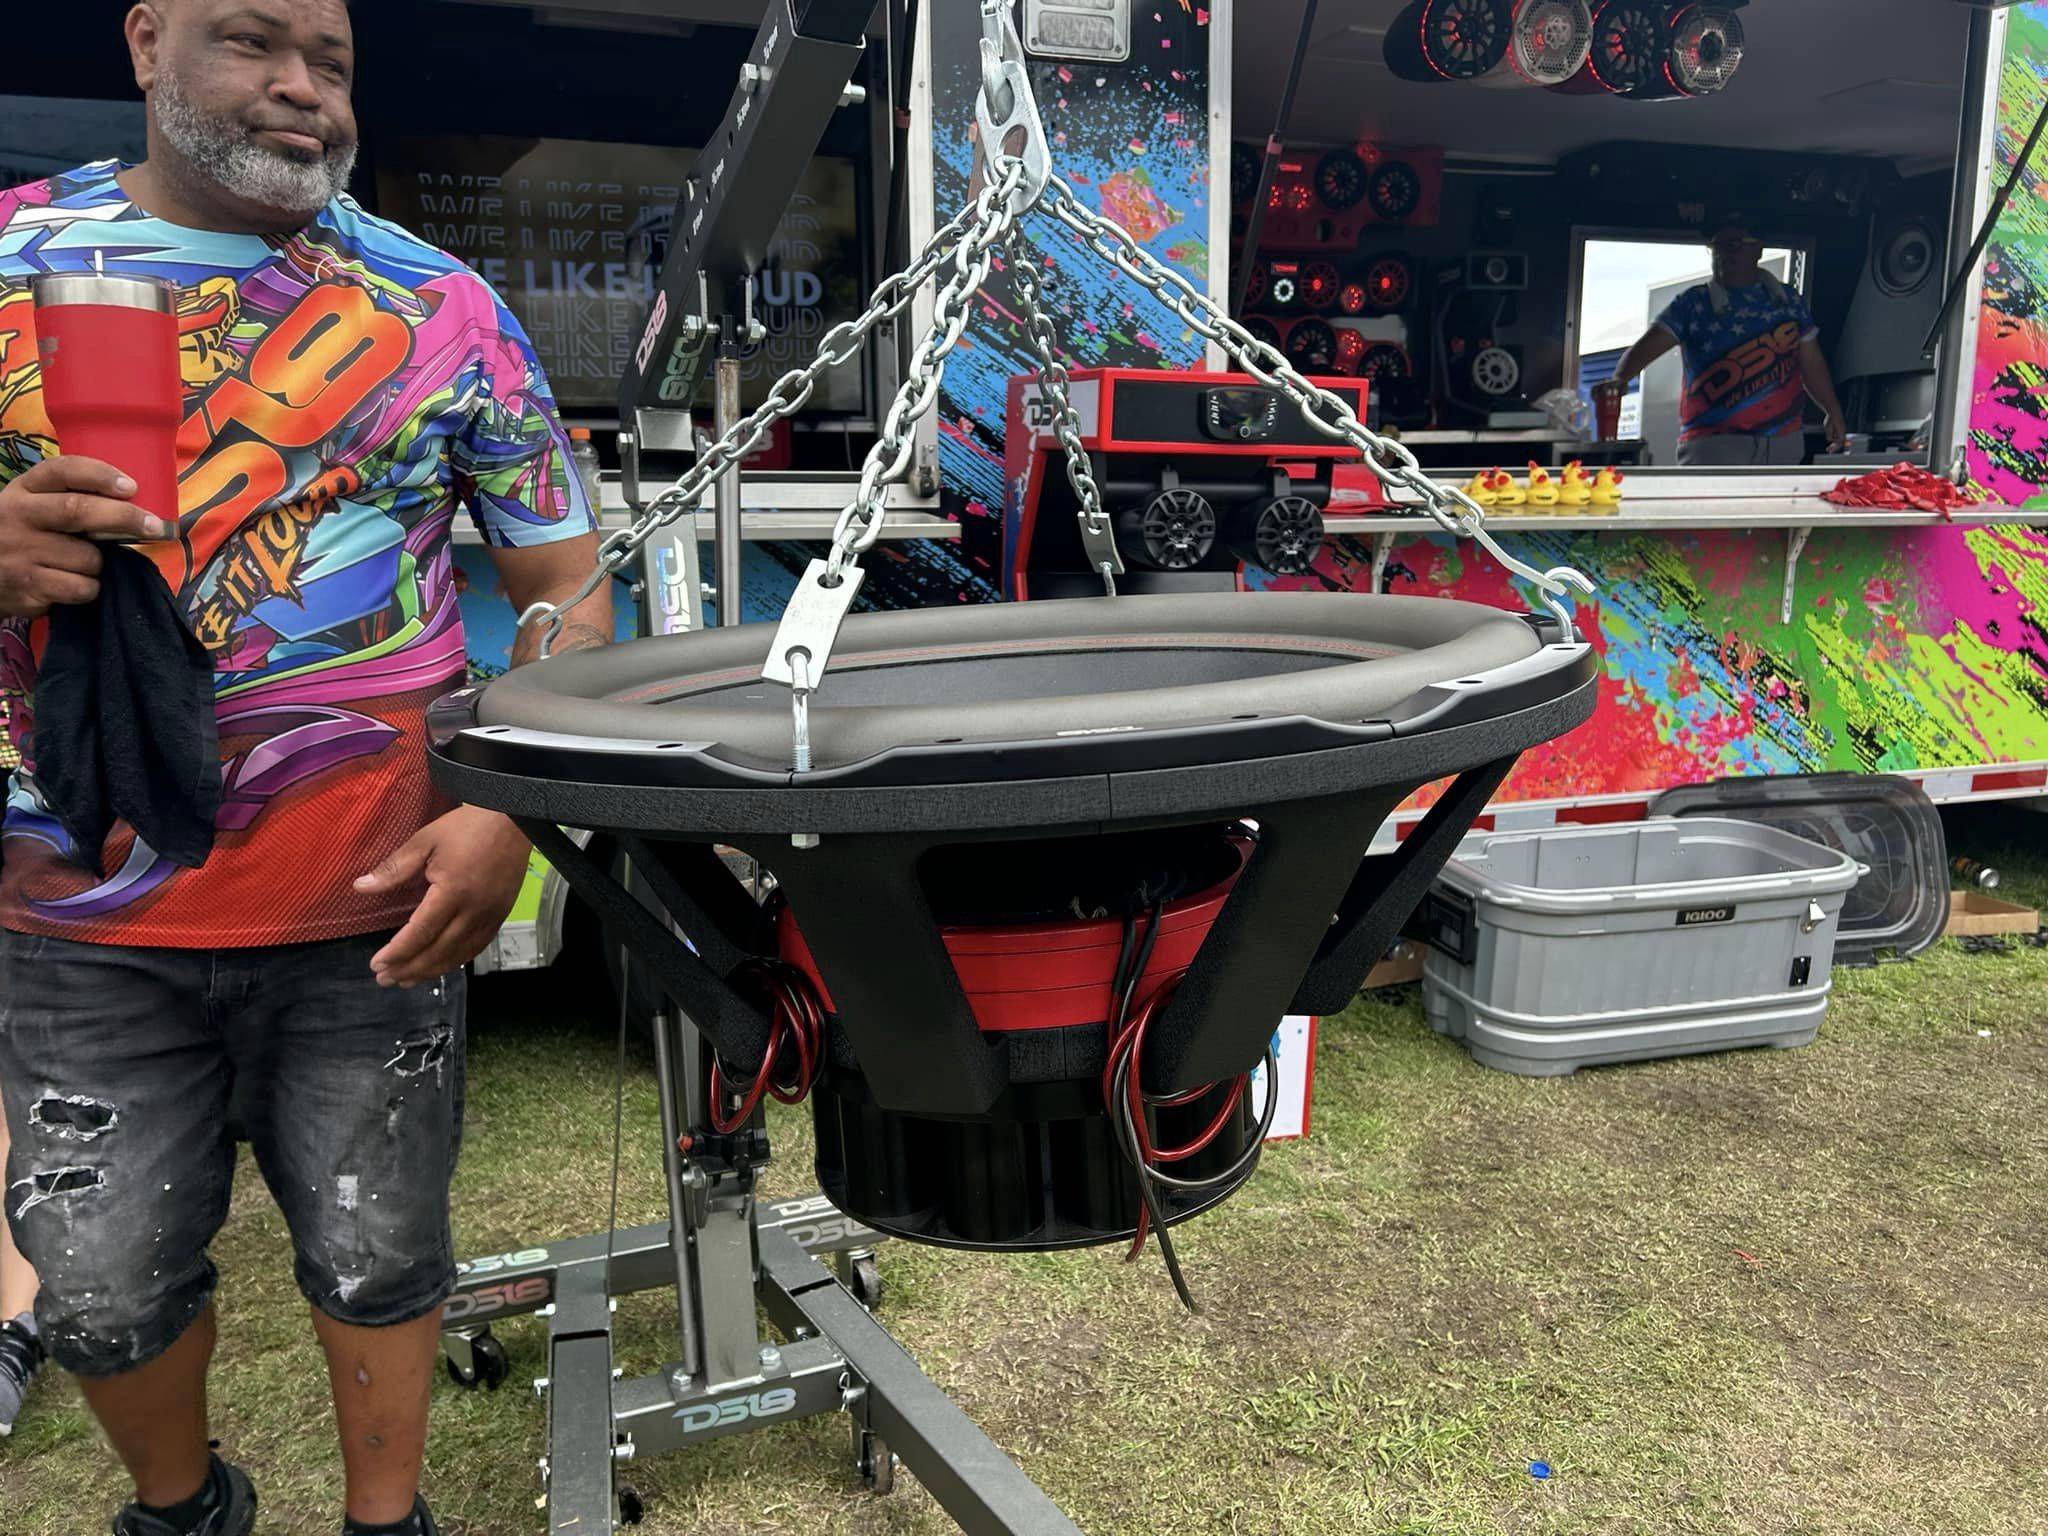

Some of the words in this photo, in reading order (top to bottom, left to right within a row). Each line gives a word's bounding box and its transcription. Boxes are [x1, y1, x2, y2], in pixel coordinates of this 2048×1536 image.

[524, 260, 628, 301] LIKE
[442, 1277, 549, 1319] DS18
[671, 1387, 797, 1433] DS18
